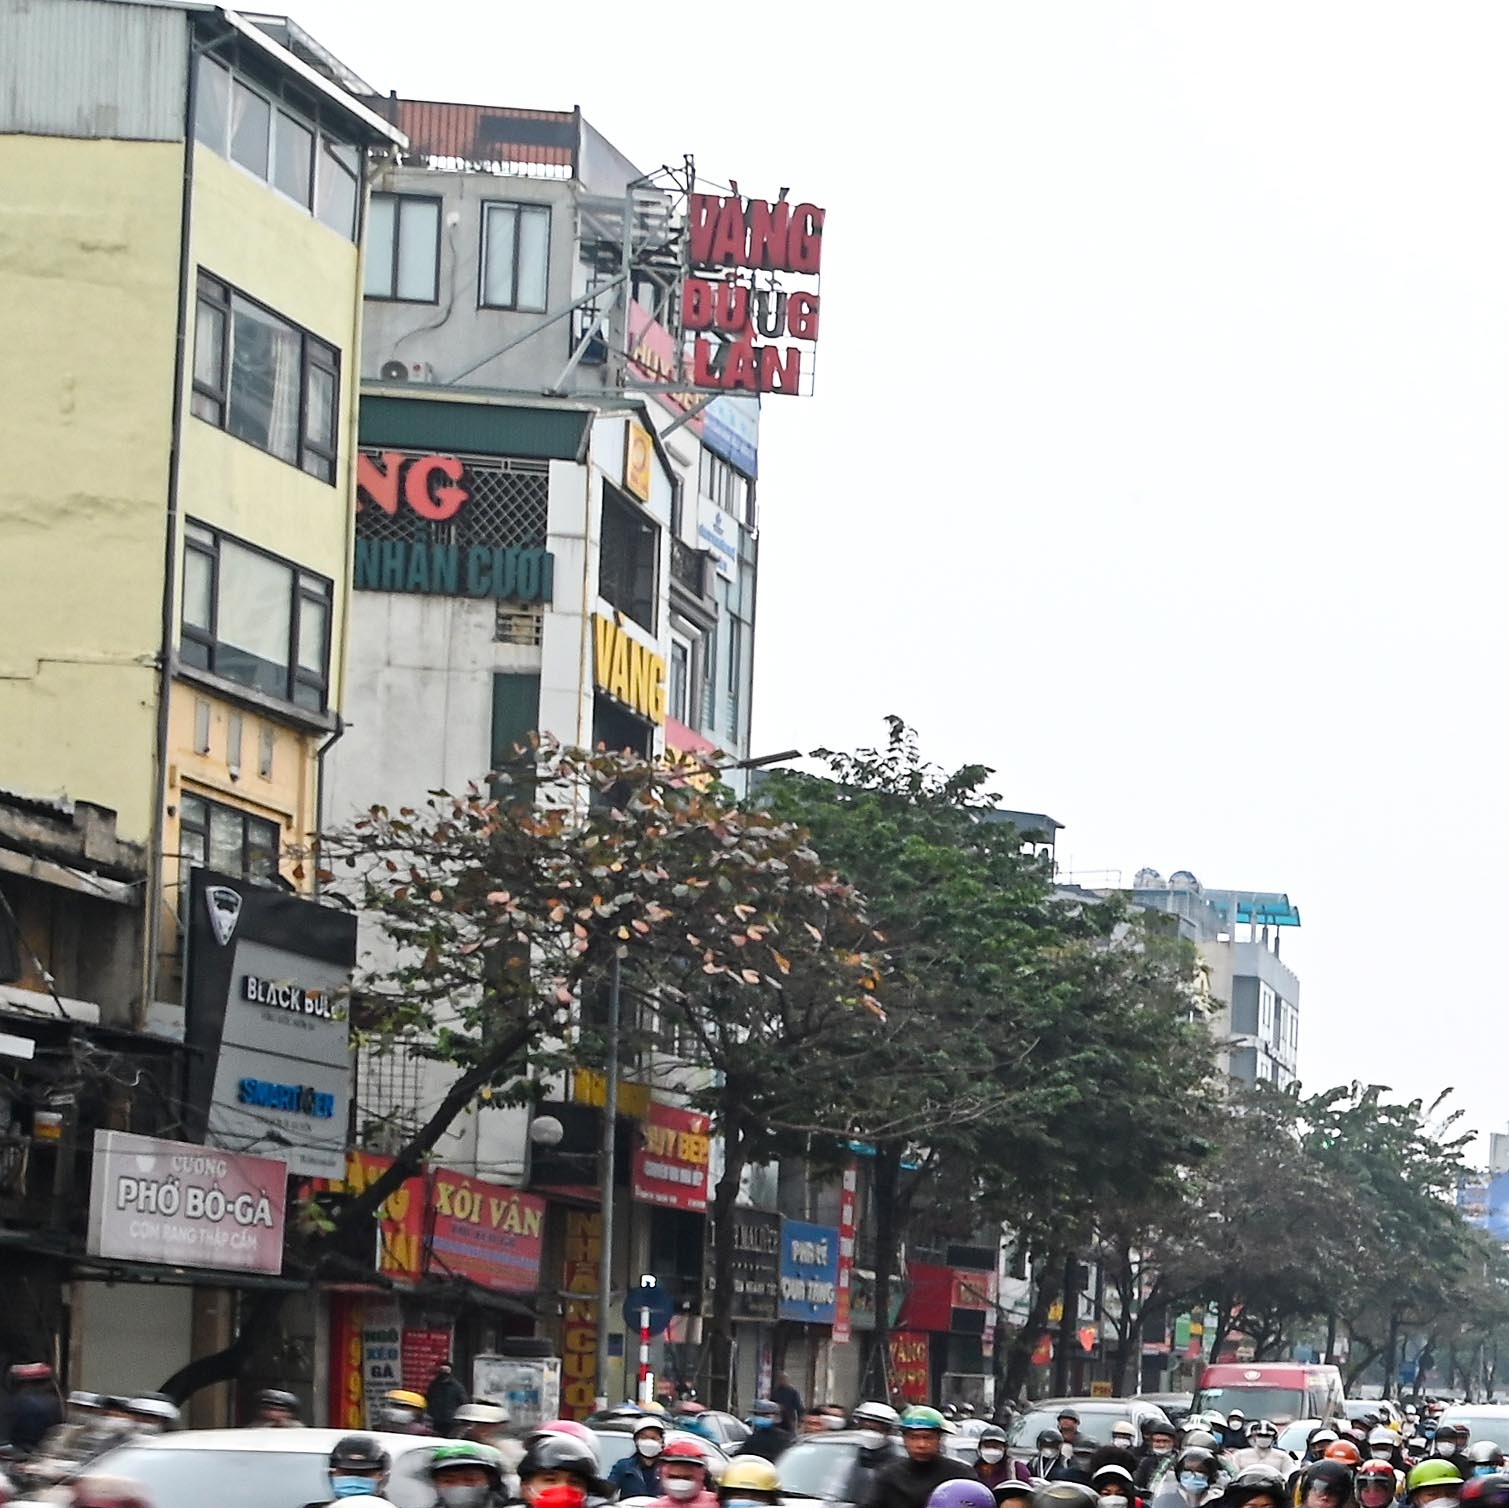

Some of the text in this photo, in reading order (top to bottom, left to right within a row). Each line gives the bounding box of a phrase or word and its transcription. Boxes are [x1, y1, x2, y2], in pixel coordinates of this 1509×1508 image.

[690, 179, 826, 274] VÀNG
[591, 610, 667, 727] VÀNG
[242, 975, 301, 1013] BLACK
[117, 1174, 181, 1216] PHỞ
[434, 1181, 482, 1225] XÔI
